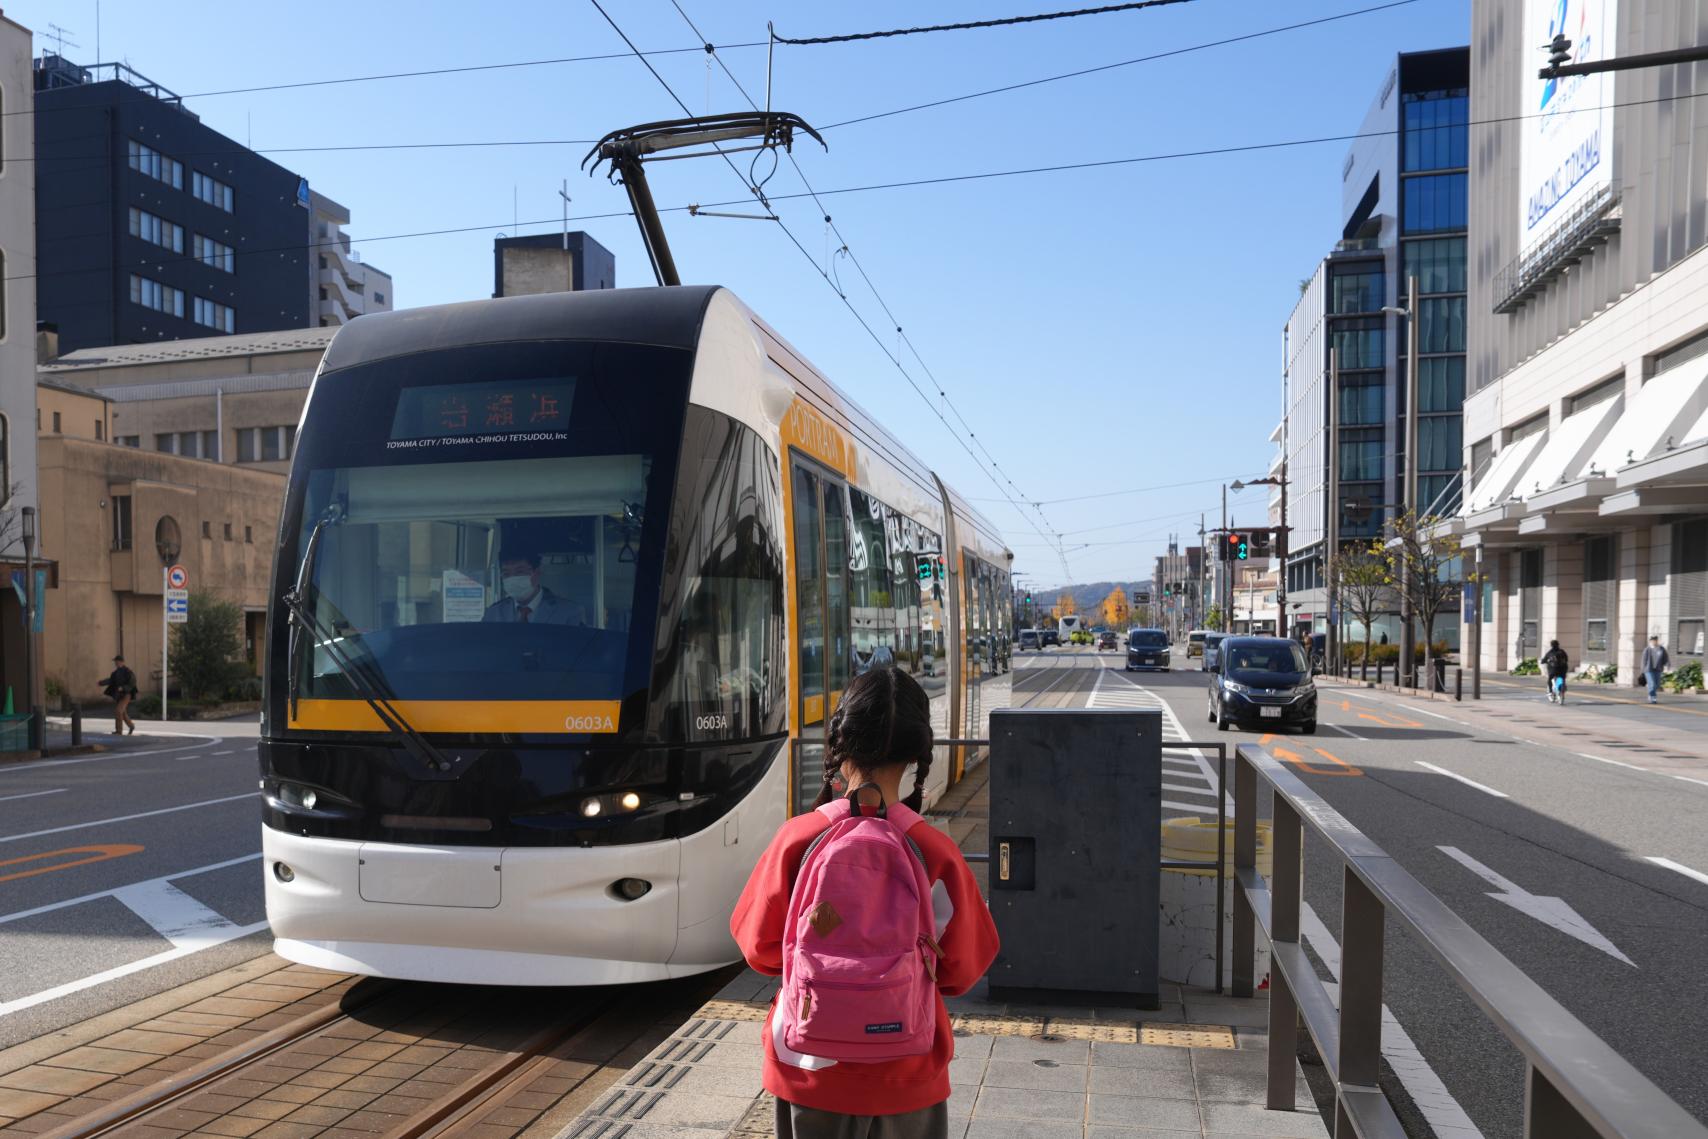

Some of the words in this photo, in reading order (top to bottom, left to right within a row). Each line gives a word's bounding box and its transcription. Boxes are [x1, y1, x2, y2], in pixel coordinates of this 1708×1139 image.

[1565, 129, 1600, 190] TOYAMA
[386, 440, 417, 449] TOYAMA
[418, 439, 436, 447] CITY
[442, 437, 473, 445] TOYAMA
[475, 435, 507, 444] CHIHOU
[509, 432, 554, 442] TETSUDOU,
[555, 432, 568, 440] Inc
[790, 403, 839, 464] PORTRAM
[565, 715, 614, 730] 0603A
[696, 715, 728, 730] 0603A
